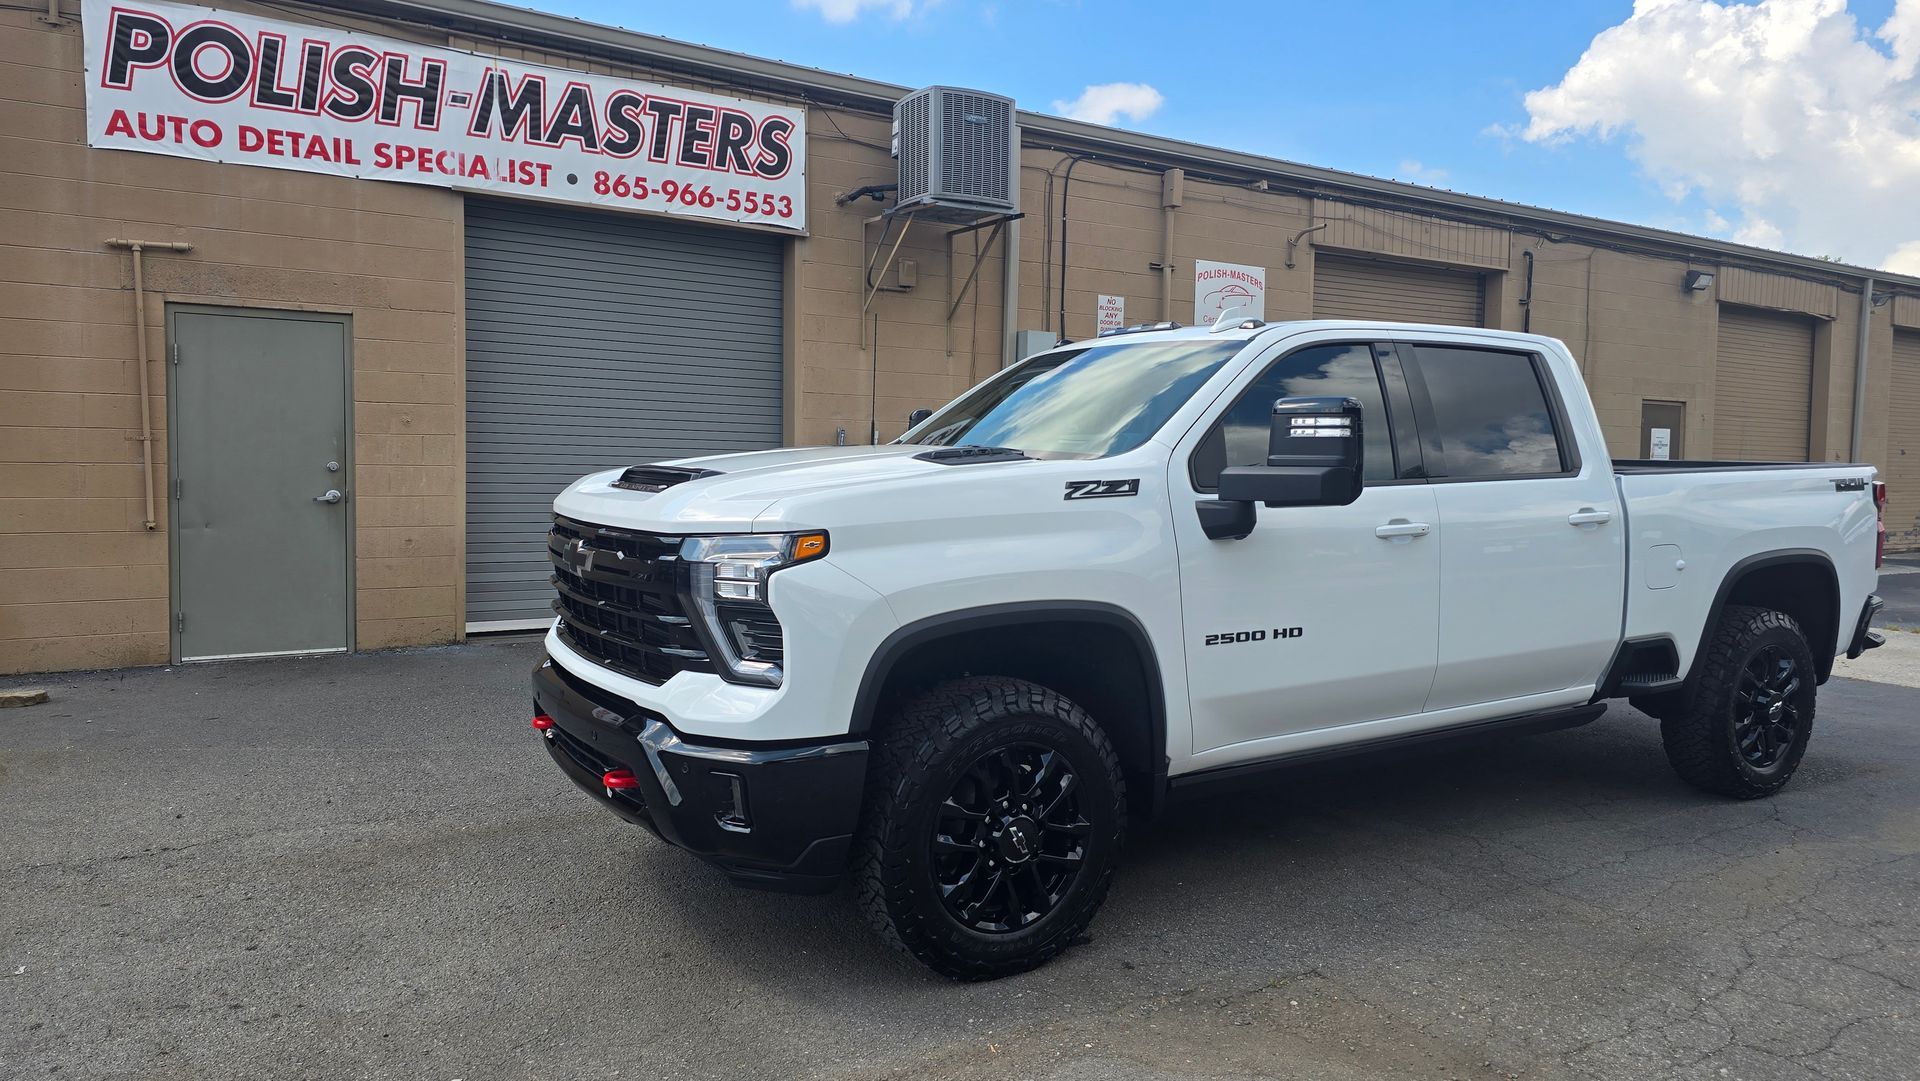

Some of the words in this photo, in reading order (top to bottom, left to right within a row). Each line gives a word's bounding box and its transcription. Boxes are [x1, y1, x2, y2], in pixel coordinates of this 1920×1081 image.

[101, 7, 796, 180] POLISH-MASTERS
[104, 109, 223, 148] AUTO
[238, 125, 361, 166] DETAIL
[593, 171, 793, 218] 865-966-5553
[1197, 269, 1263, 290] POLISH-MASTERS
[1205, 630, 1265, 646] 2500
[1273, 627, 1303, 640] HD
